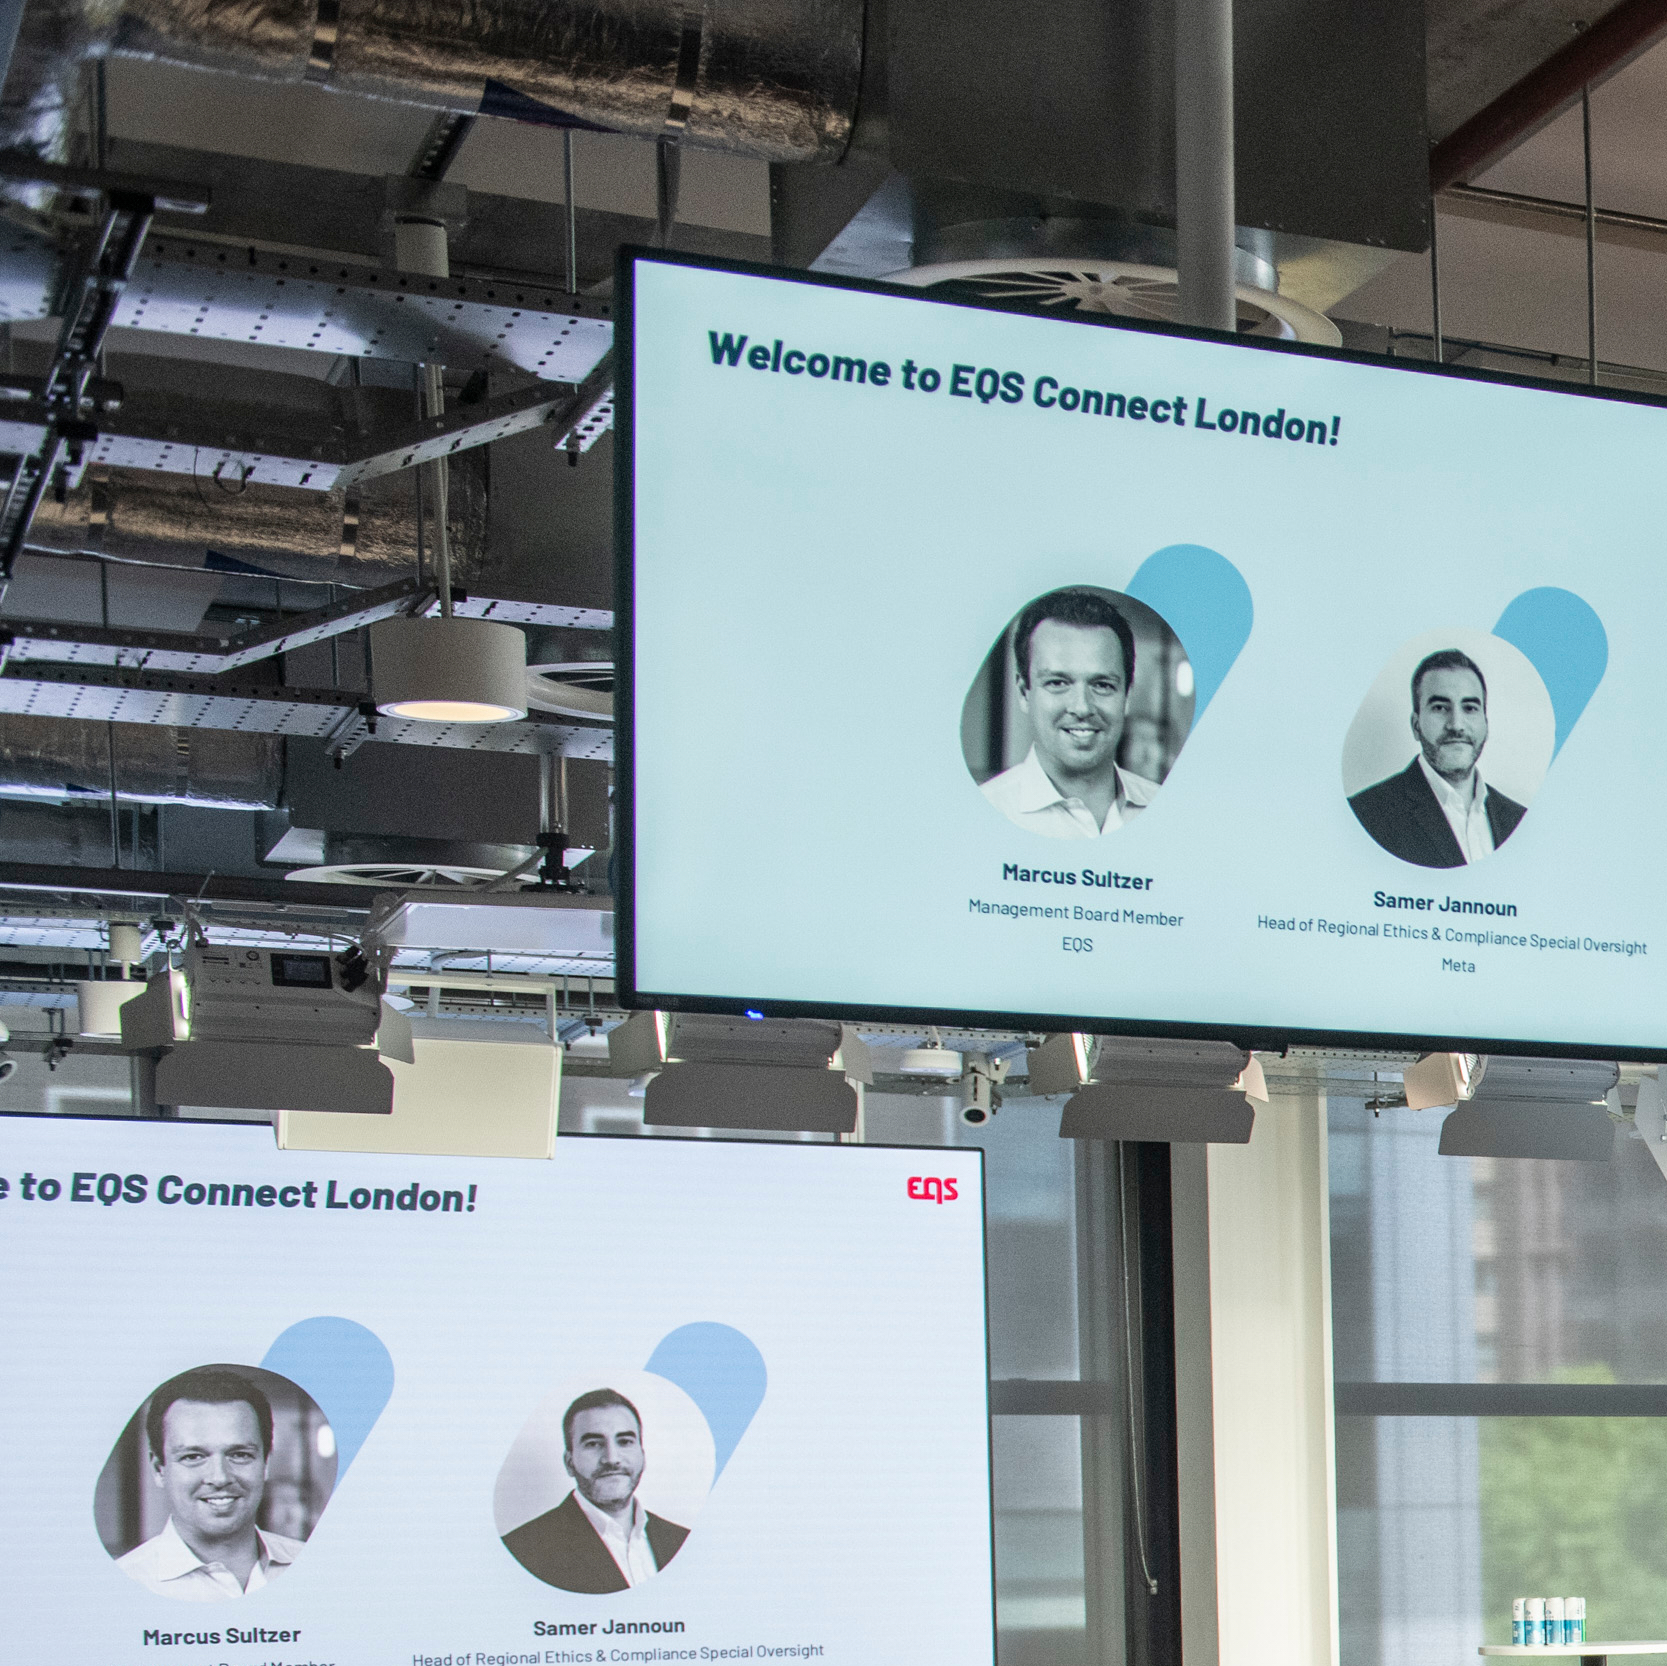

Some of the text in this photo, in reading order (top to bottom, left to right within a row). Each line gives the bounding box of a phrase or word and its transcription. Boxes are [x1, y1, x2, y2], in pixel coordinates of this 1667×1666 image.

[708, 330, 1341, 446] Welcome to EQS Connect London!
[1002, 863, 1153, 891] Marcus Sultzer
[968, 898, 1184, 927] Management Board Member
[1373, 890, 1517, 917] Samer Jannoun
[1062, 936, 1094, 954] EQS
[1257, 915, 1648, 957] Head of Regional Ethics & Compliance Special Oversight
[1441, 957, 1476, 973] Meta
[19, 1172, 62, 1202] to
[70, 1172, 149, 1207] EQS
[156, 1174, 318, 1209] Connect
[325, 1179, 478, 1213] London!
[907, 1176, 959, 1205] EQS
[142, 1627, 302, 1646] Marcus Sultzer
[533, 1619, 685, 1637] Samer Jannoun
[455, 1653, 471, 1666] of
[544, 1650, 593, 1664] Ethics
[595, 1649, 607, 1663] &
[609, 1647, 697, 1664] Compliance
[699, 1645, 753, 1662] Special
[756, 1644, 824, 1660] Oversight
